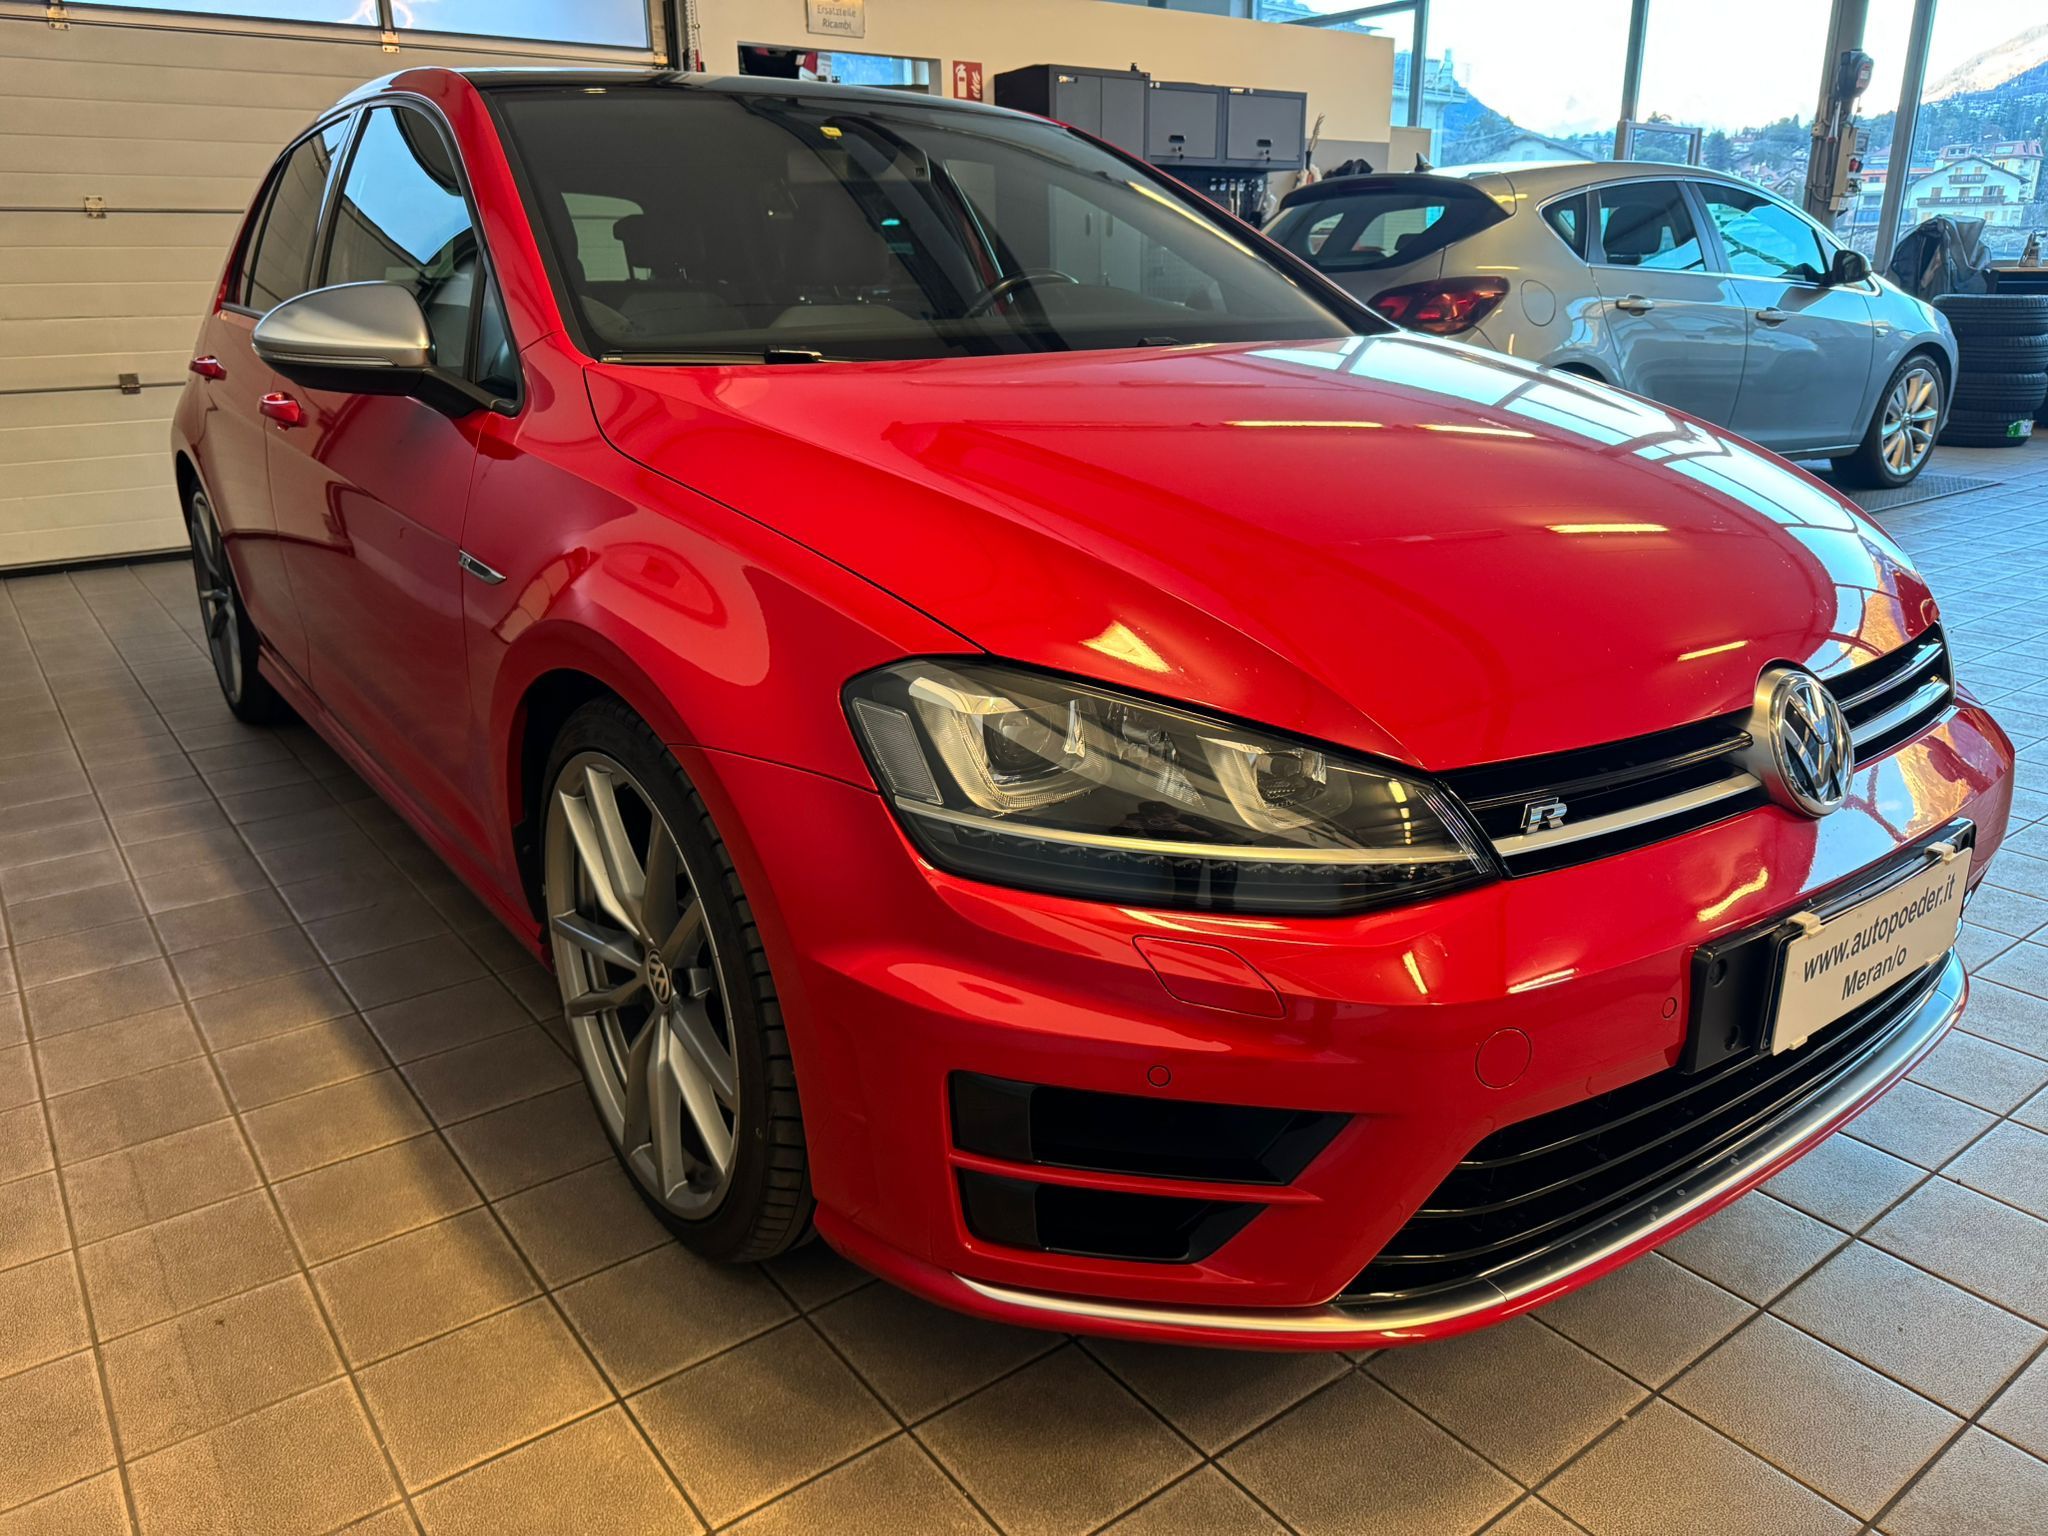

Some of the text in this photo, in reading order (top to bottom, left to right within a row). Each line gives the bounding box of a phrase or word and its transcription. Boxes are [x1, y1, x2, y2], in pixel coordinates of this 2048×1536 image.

[822, 18, 851, 30] Ricambi
[1522, 798, 1567, 834] R
[1803, 872, 1955, 983] www.autopoeder.it
[1842, 945, 1907, 1000] Meran/o
